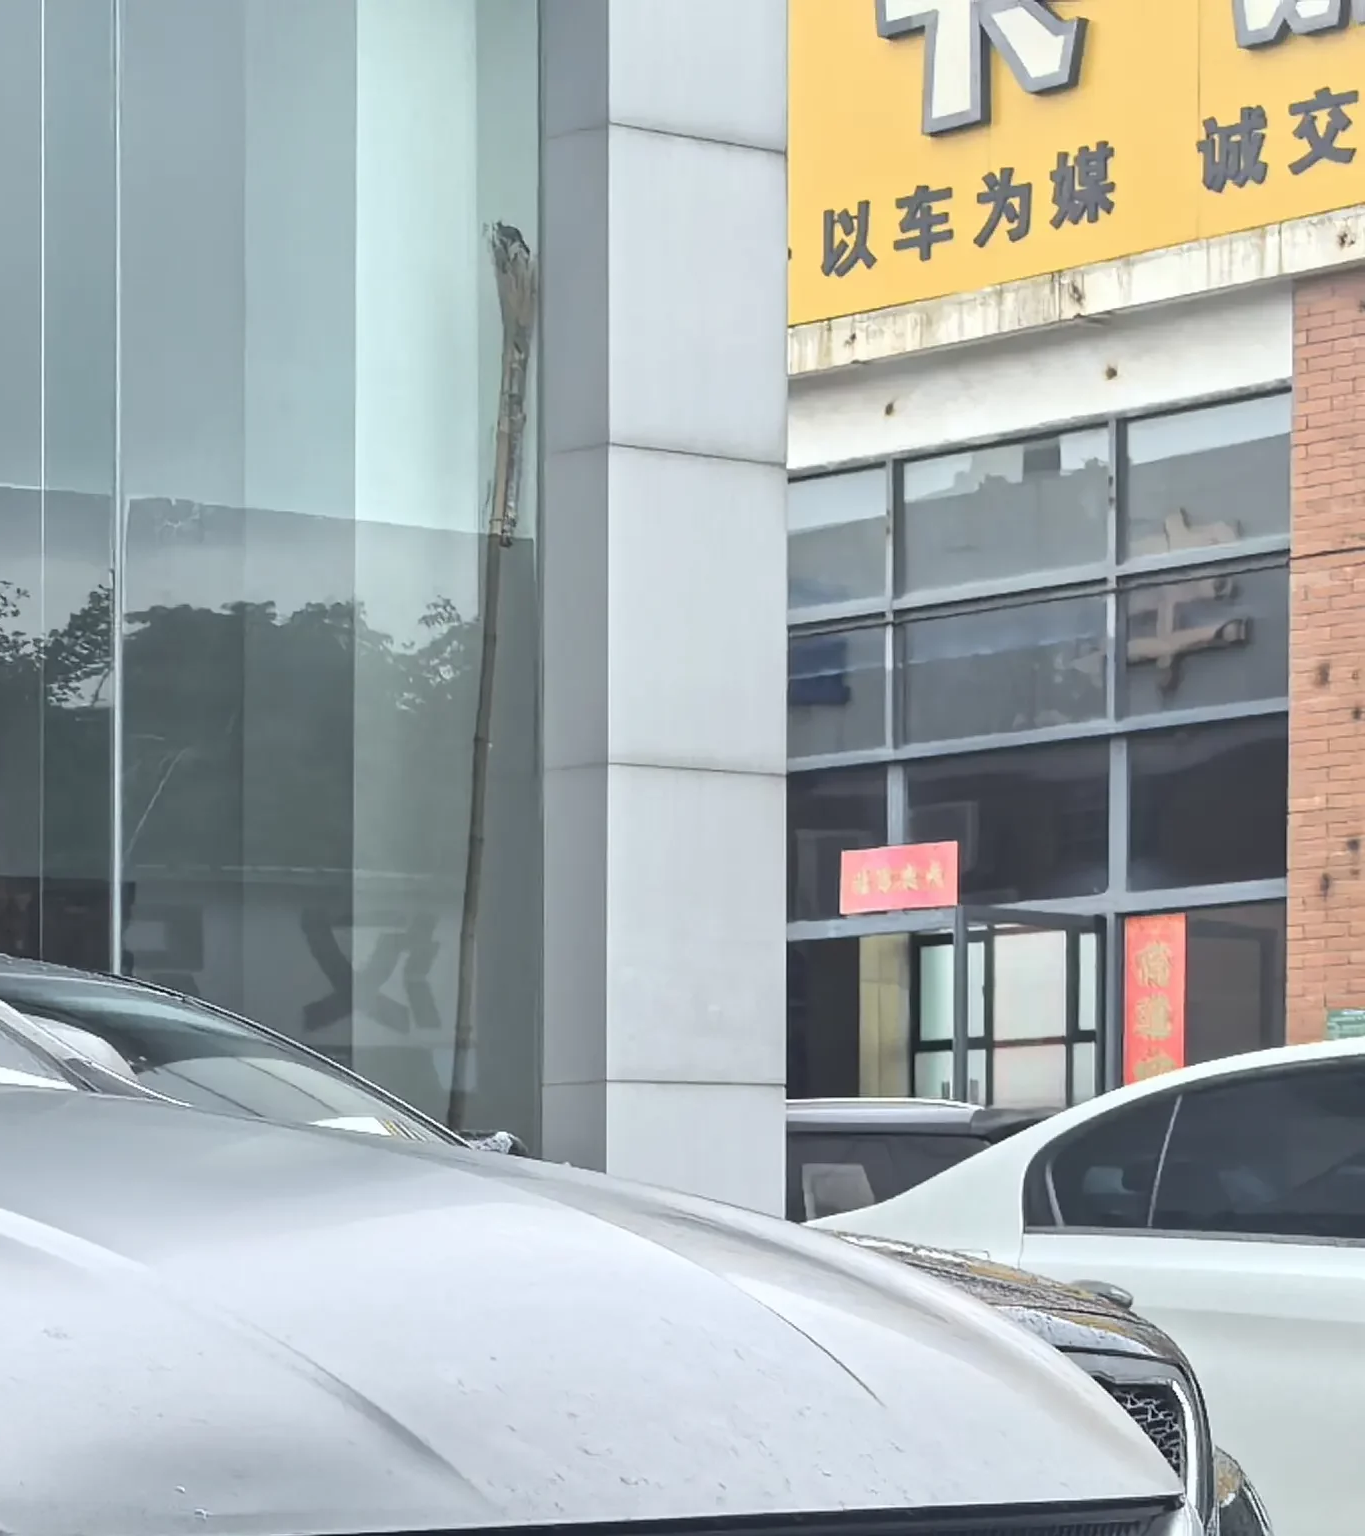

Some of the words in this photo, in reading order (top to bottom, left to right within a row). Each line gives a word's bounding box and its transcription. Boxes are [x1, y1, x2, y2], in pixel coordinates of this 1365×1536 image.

[820, 141, 1116, 277] 以车为媒
[1197, 87, 1359, 193] 诚交
